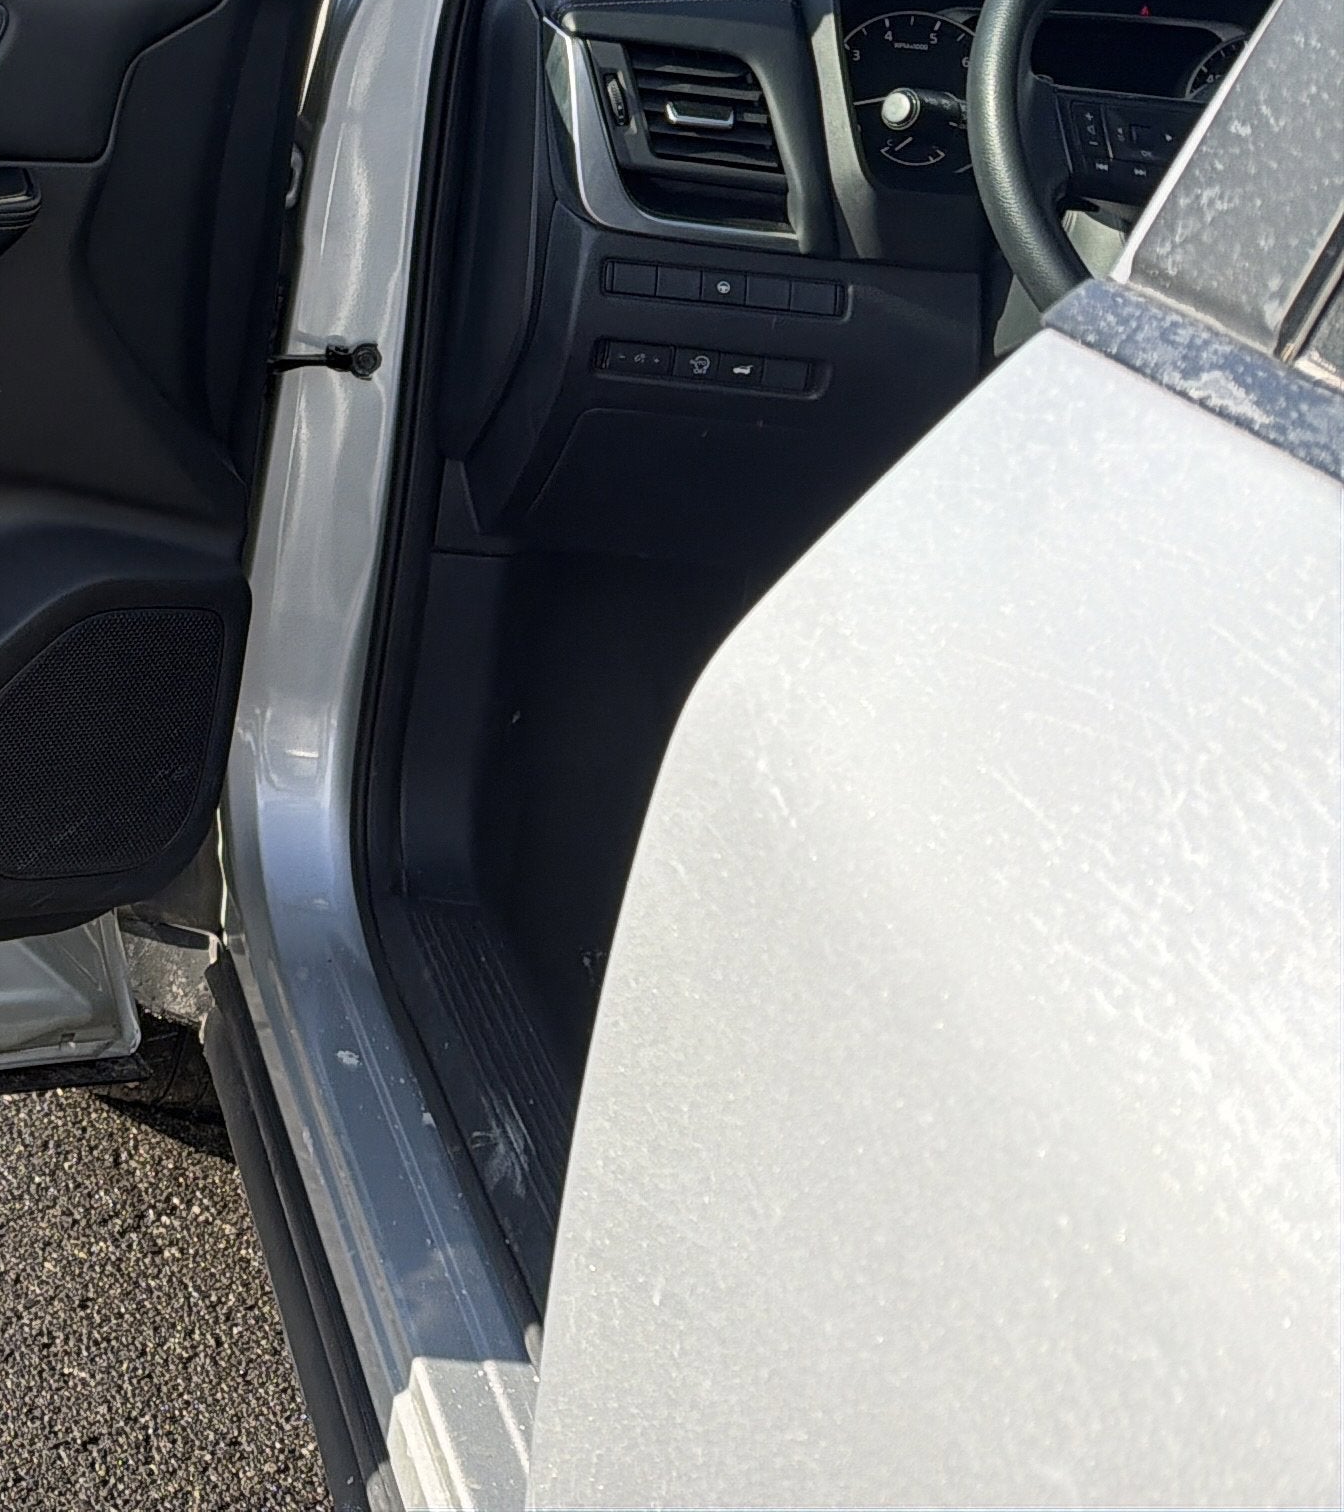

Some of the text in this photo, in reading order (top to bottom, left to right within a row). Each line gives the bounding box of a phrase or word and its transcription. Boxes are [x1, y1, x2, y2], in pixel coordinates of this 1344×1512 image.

[884, 31, 893, 41] 4
[929, 33, 938, 44] 5
[852, 50, 861, 61] 3
[962, 57, 970, 68] 6
